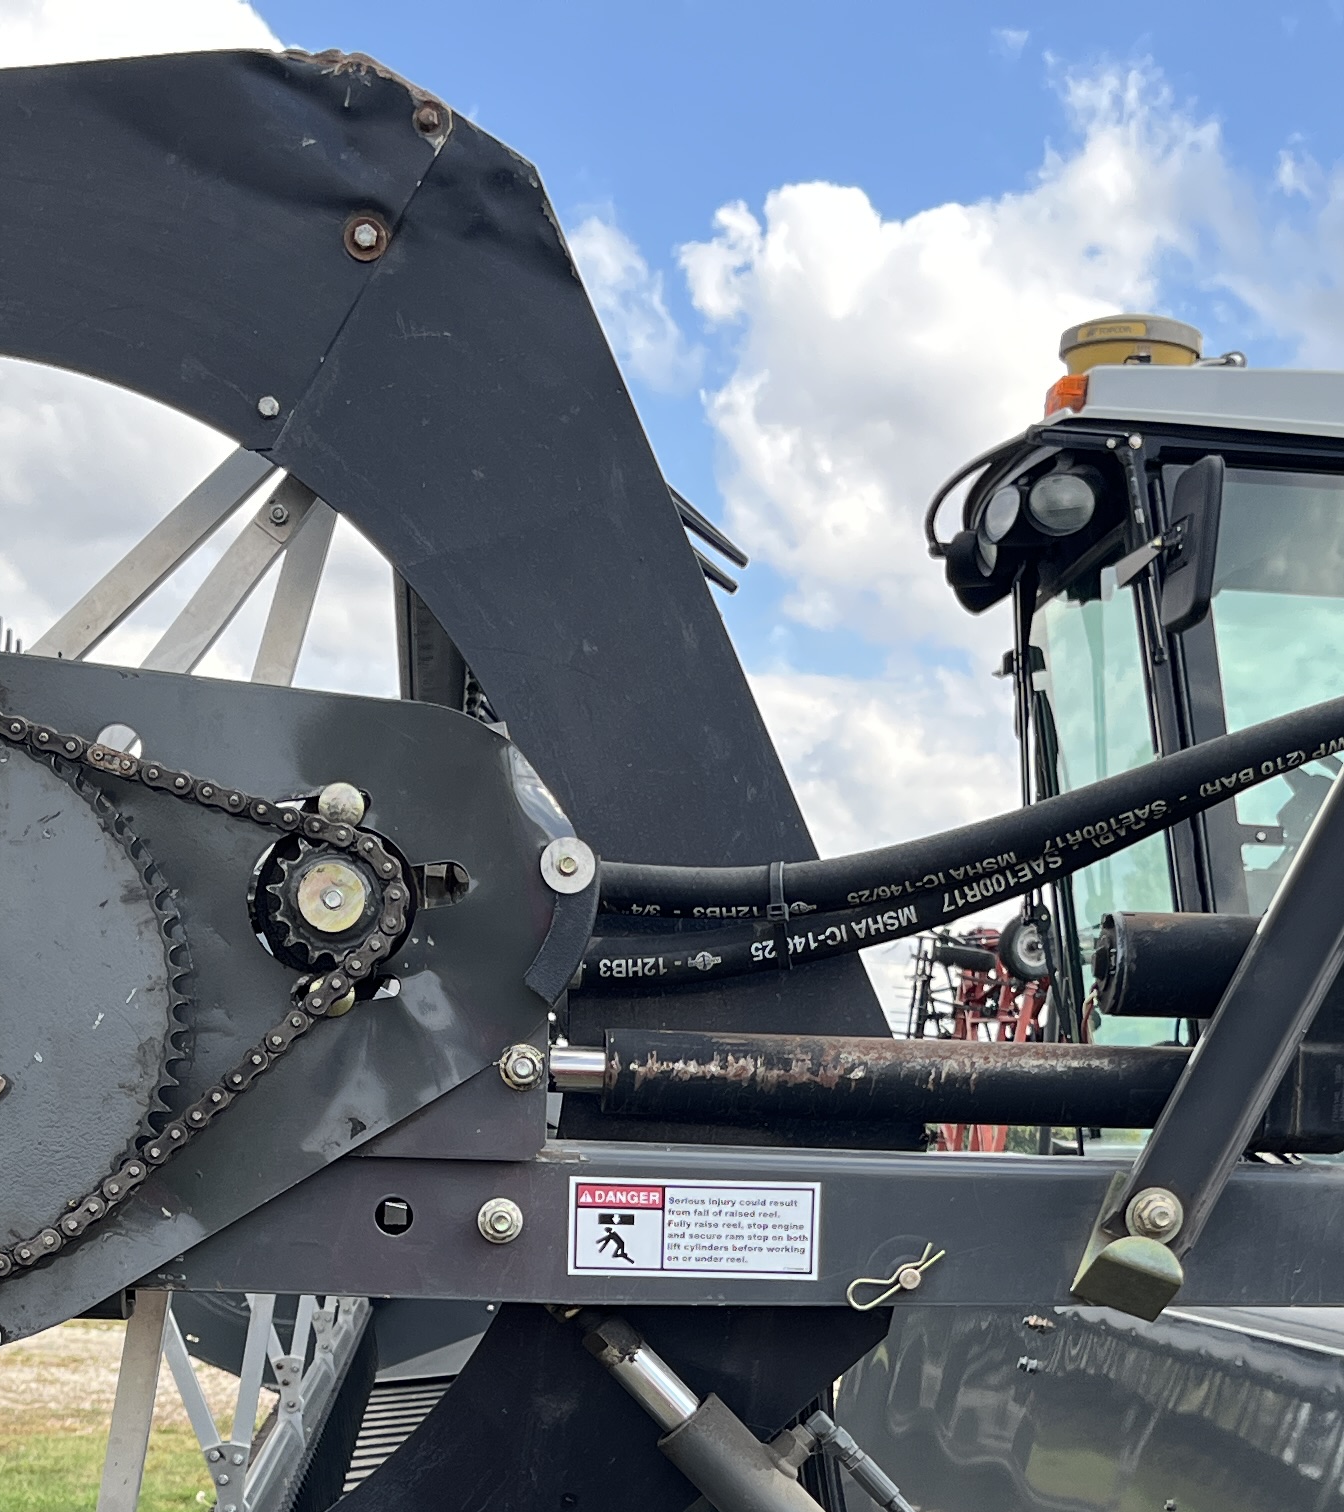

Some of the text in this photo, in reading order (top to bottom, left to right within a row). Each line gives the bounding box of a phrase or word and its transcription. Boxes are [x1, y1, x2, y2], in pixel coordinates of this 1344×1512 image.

[1260, 749, 1306, 775] (210
[1198, 766, 1254, 798] BAR)
[1042, 799, 1167, 856] SAE100R17
[948, 849, 1017, 881] MSHA
[846, 871, 944, 907] IC-146/25
[941, 850, 1063, 913] SAE100R17
[851, 904, 919, 939] MSHA
[599, 956, 669, 978] 12HB3
[594, 1189, 660, 1205] DANGER
[708, 1197, 736, 1208] injury
[739, 1198, 767, 1207] could
[769, 1199, 798, 1207] result
[667, 1208, 691, 1217] from
[693, 1209, 710, 1217] fall
[712, 1209, 723, 1217] of
[724, 1209, 756, 1218] raised
[667, 1219, 691, 1230] Fully
[694, 1221, 719, 1229] raise
[747, 1222, 769, 1232] stop
[771, 1223, 805, 1232] engine
[667, 1231, 686, 1240] and
[747, 1233, 769, 1243] stop
[786, 1234, 809, 1242] both
[683, 1243, 729, 1253] cylinders
[731, 1244, 764, 1253] before
[766, 1246, 806, 1255] working
[694, 1255, 723, 1263] under
